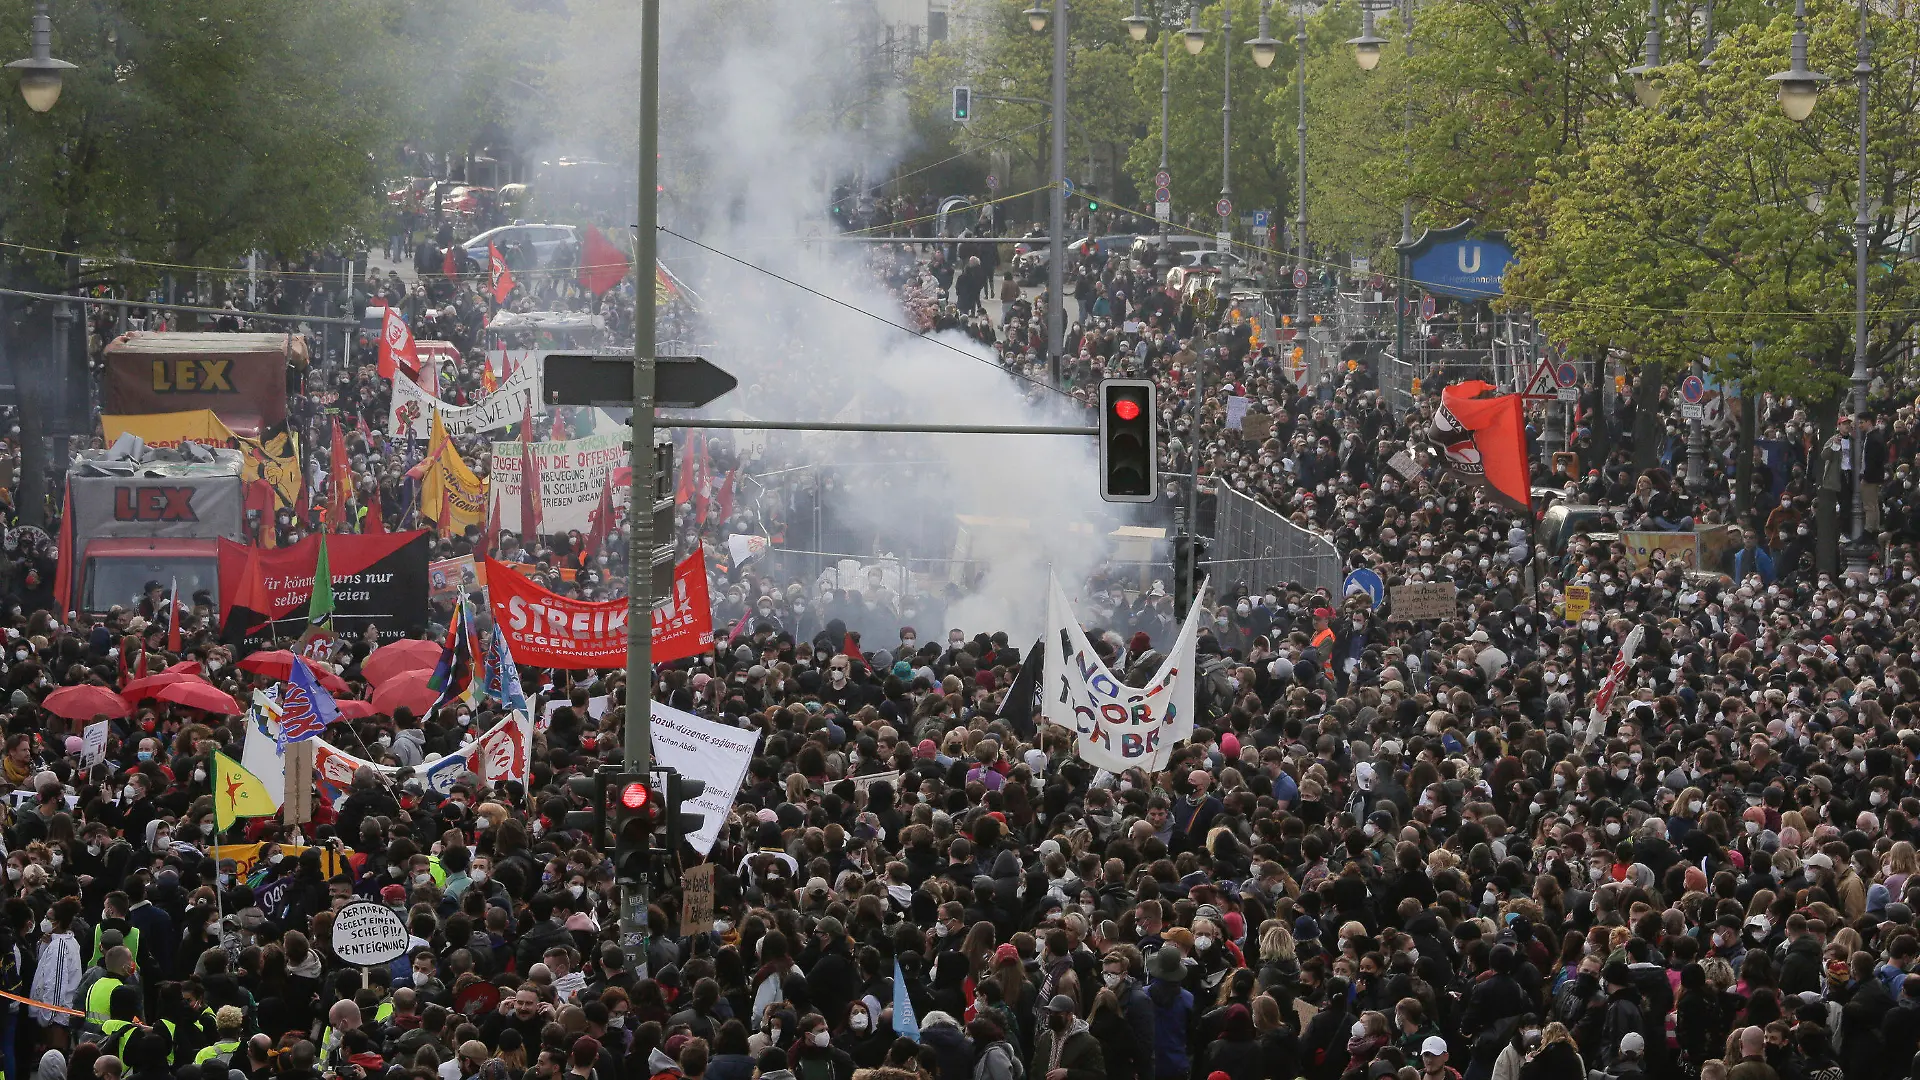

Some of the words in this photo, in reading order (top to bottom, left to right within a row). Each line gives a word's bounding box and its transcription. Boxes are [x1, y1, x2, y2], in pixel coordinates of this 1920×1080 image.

[1256, 213, 1264, 225] P
[1458, 246, 1481, 274] U
[1449, 275, 1504, 286] Hermannplat
[152, 360, 235, 392] LEX
[553, 455, 570, 469] DIE
[553, 480, 589, 495] SCHULEN
[114, 486, 200, 522] LEX
[333, 574, 361, 584] uns
[366, 573, 394, 583] nur
[274, 591, 309, 607] selbst
[509, 578, 688, 640] STREIKN!
[512, 632, 576, 649] GEGEN
[651, 616, 698, 637] RISE.
[650, 713, 675, 730] Bozuk
[657, 735, 679, 747] Sultan
[342, 907, 360, 920] DER
[360, 905, 390, 917] MARKT
[337, 917, 367, 931] REGELT
